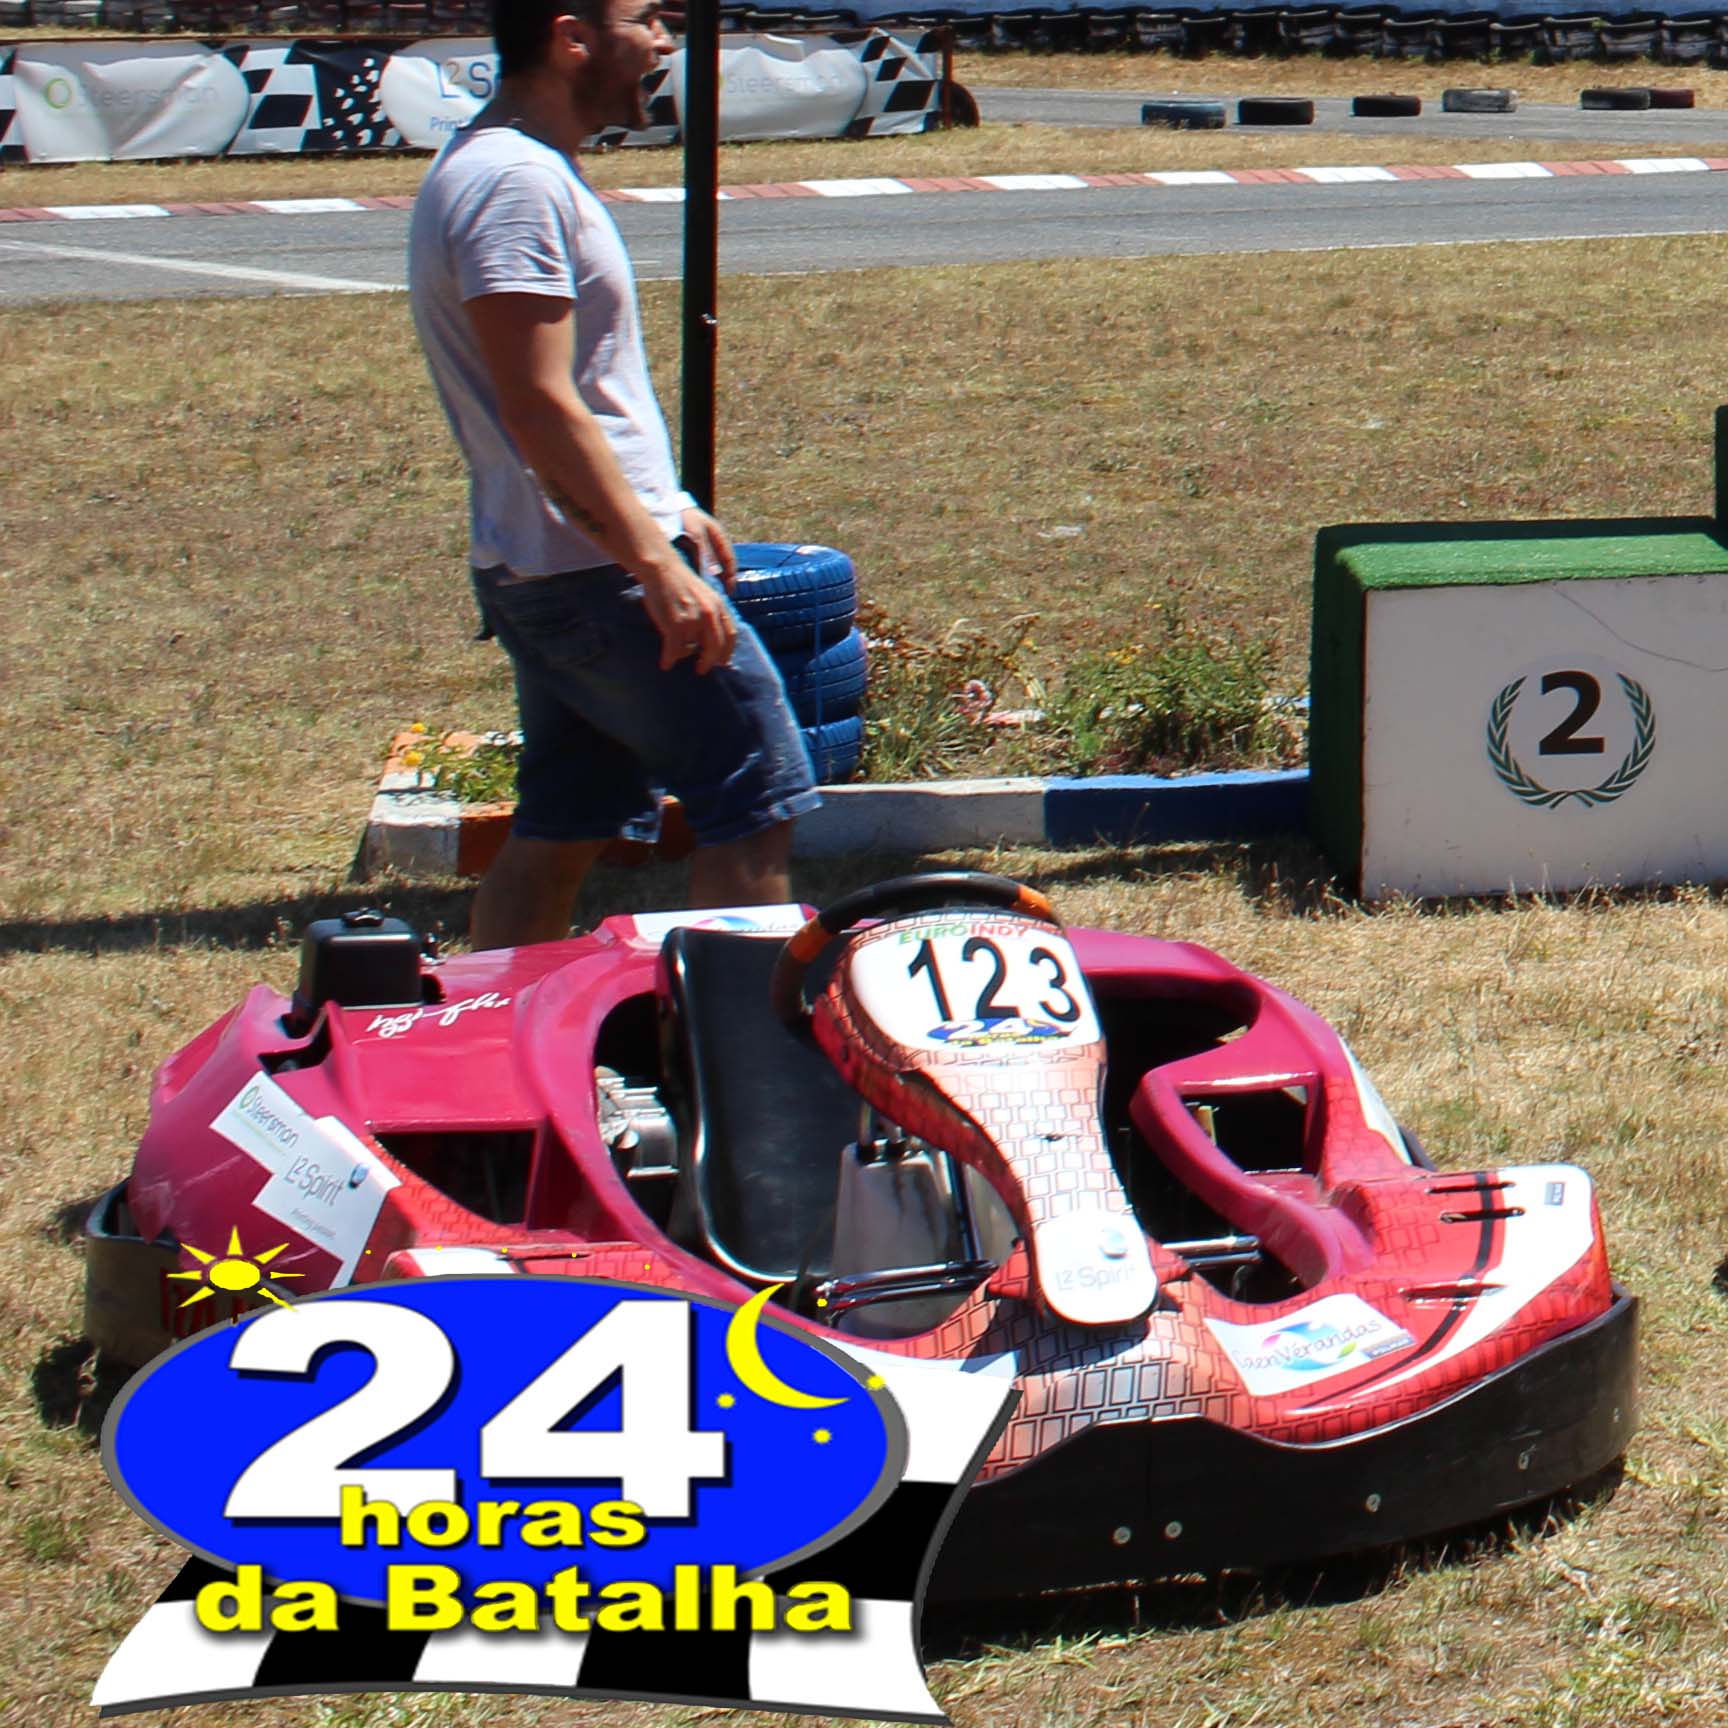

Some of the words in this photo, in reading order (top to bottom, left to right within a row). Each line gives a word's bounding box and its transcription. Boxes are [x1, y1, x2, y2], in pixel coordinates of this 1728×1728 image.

[1538, 670, 1605, 756] 2
[899, 923, 1028, 945] EUROINDY
[908, 936, 1082, 1024] 123
